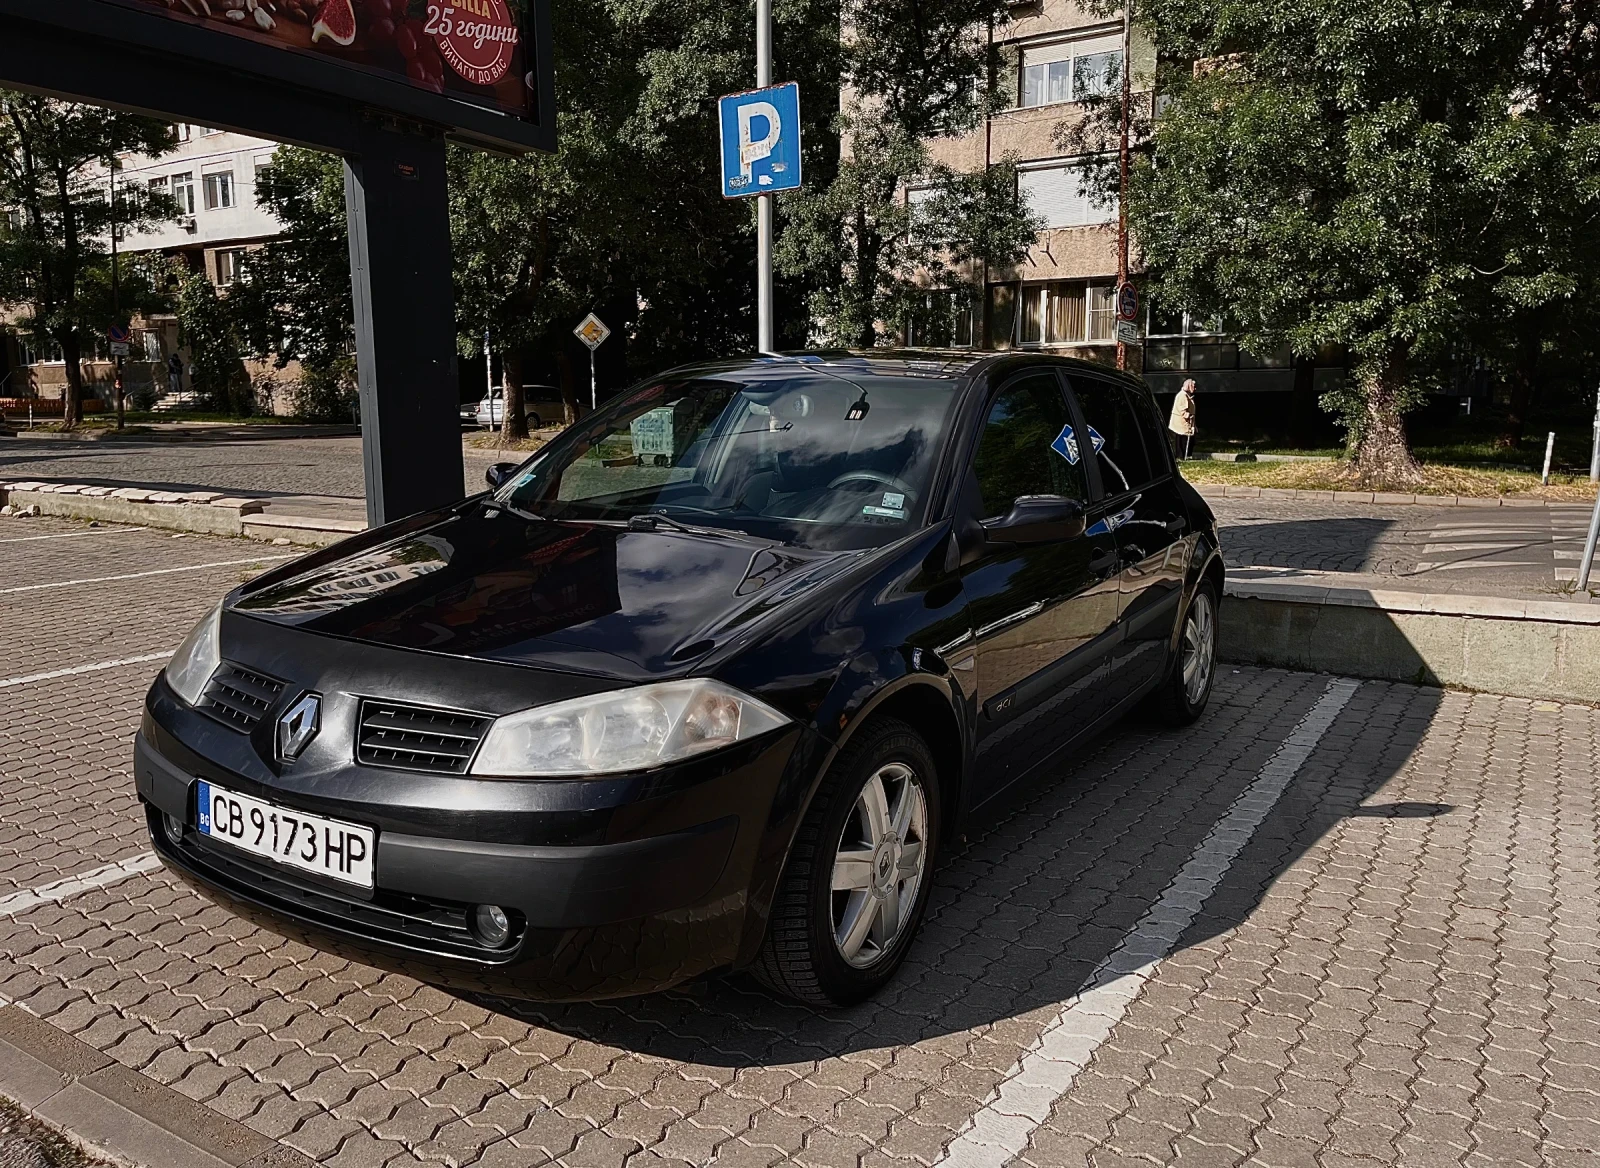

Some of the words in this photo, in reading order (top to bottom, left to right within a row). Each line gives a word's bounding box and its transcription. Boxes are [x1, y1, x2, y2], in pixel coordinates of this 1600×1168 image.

[424, 5, 455, 36] 25
[456, 20, 519, 49] години
[439, 40, 475, 80] ВИНАГИ
[478, 71, 491, 84] ДО
[492, 58, 507, 79] ВАС
[738, 101, 781, 183] P
[200, 812, 210, 826] BG
[213, 795, 244, 839] CB
[250, 807, 317, 863] 9173
[324, 827, 366, 874] HP
